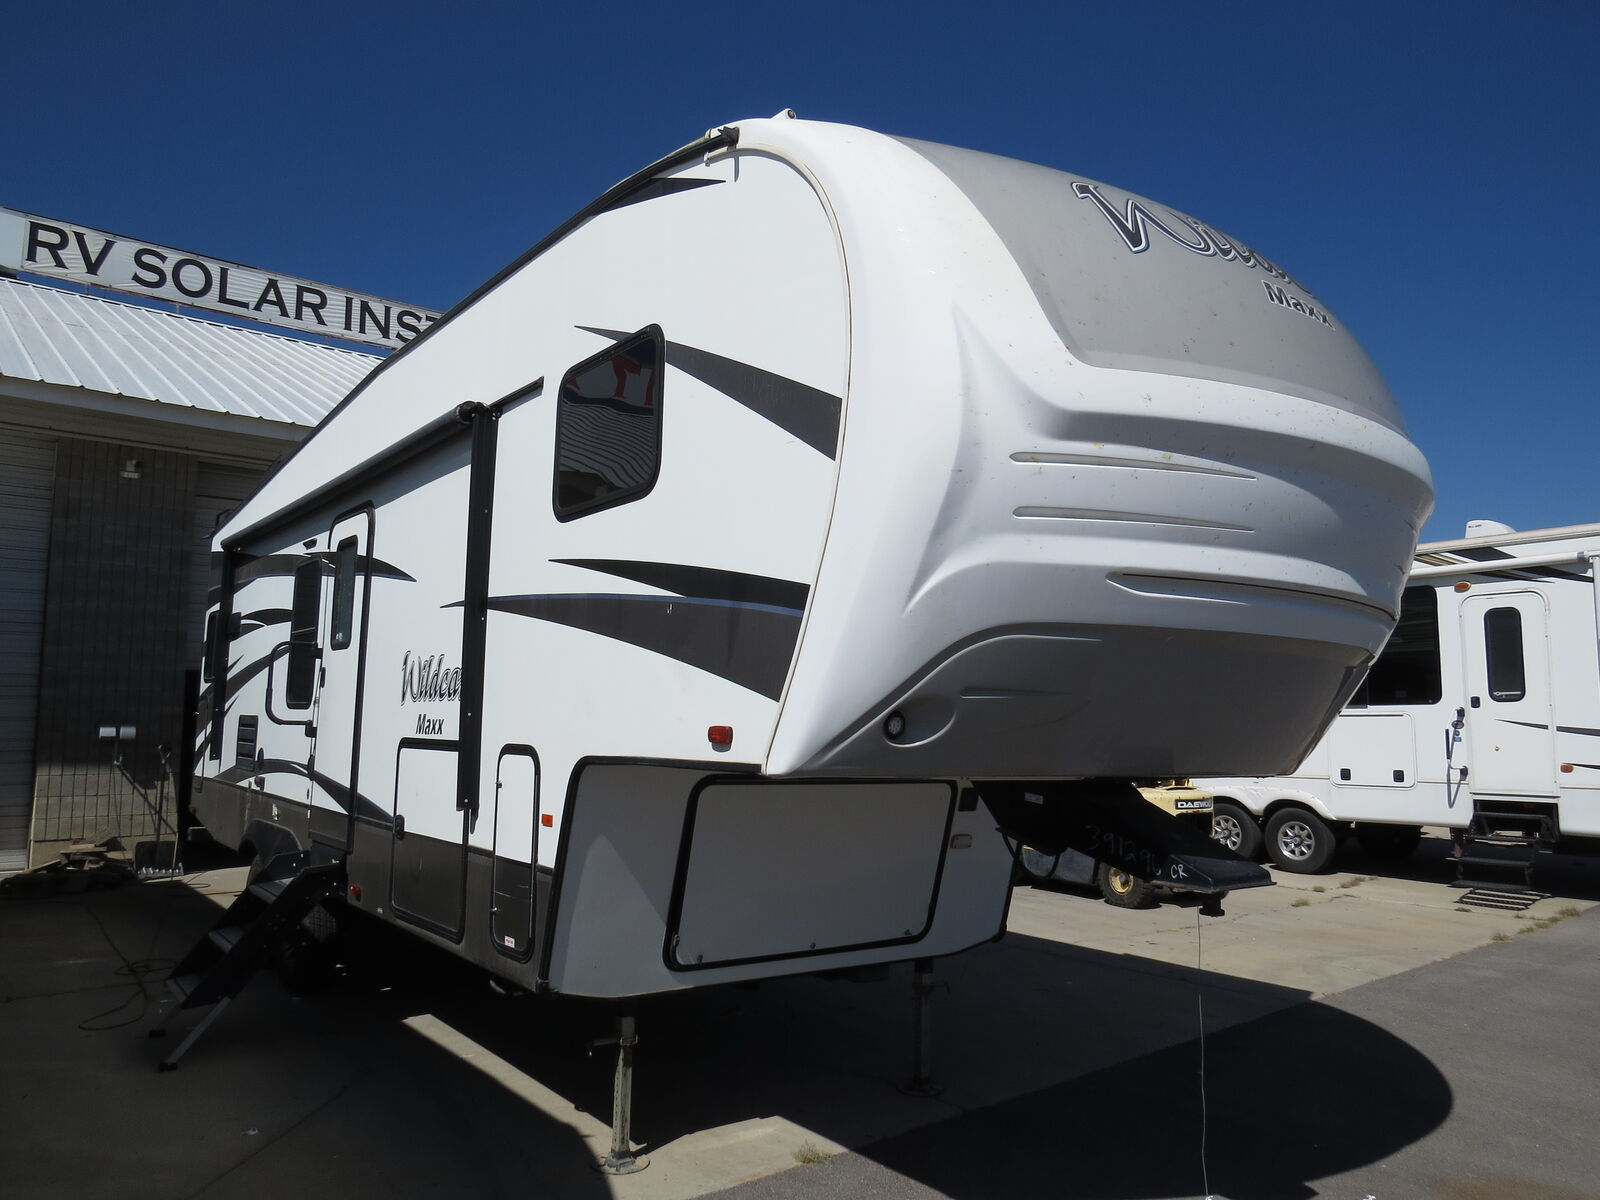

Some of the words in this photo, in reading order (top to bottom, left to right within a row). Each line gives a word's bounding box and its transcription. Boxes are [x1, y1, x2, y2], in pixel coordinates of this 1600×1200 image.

[26, 220, 116, 276] RV
[131, 247, 328, 326] SOLAR
[1261, 279, 1335, 331] Maxx
[401, 650, 462, 706] Wildca
[415, 713, 445, 735] Maxx
[1170, 864, 1188, 879] CR
